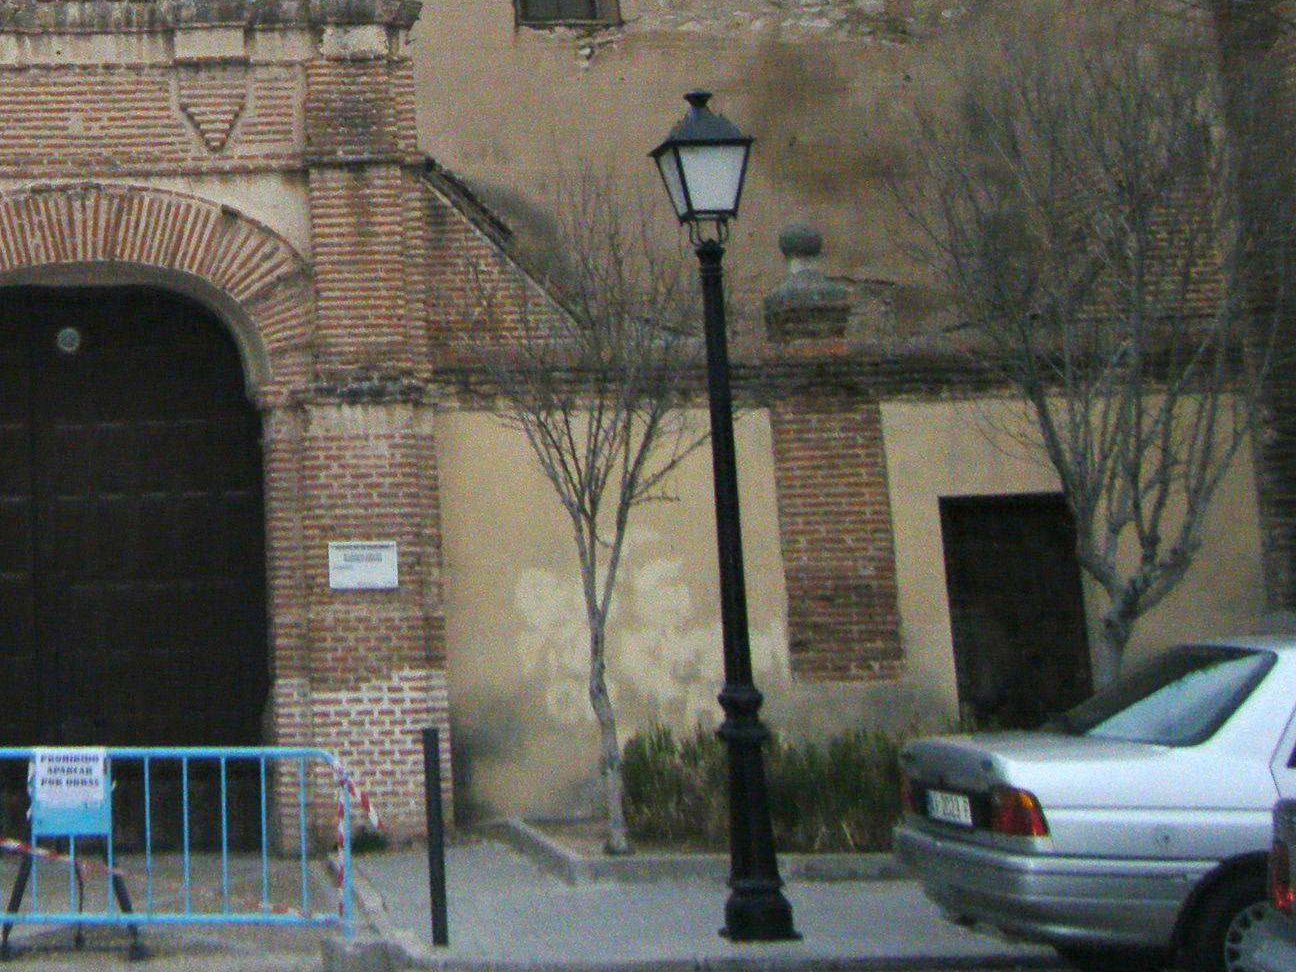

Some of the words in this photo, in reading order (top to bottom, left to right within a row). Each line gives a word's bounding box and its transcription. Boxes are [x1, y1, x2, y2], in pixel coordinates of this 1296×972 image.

[40, 754, 100, 764] PROHIBIDO
[47, 766, 93, 775] APARCAR
[40, 778, 62, 786] POR
